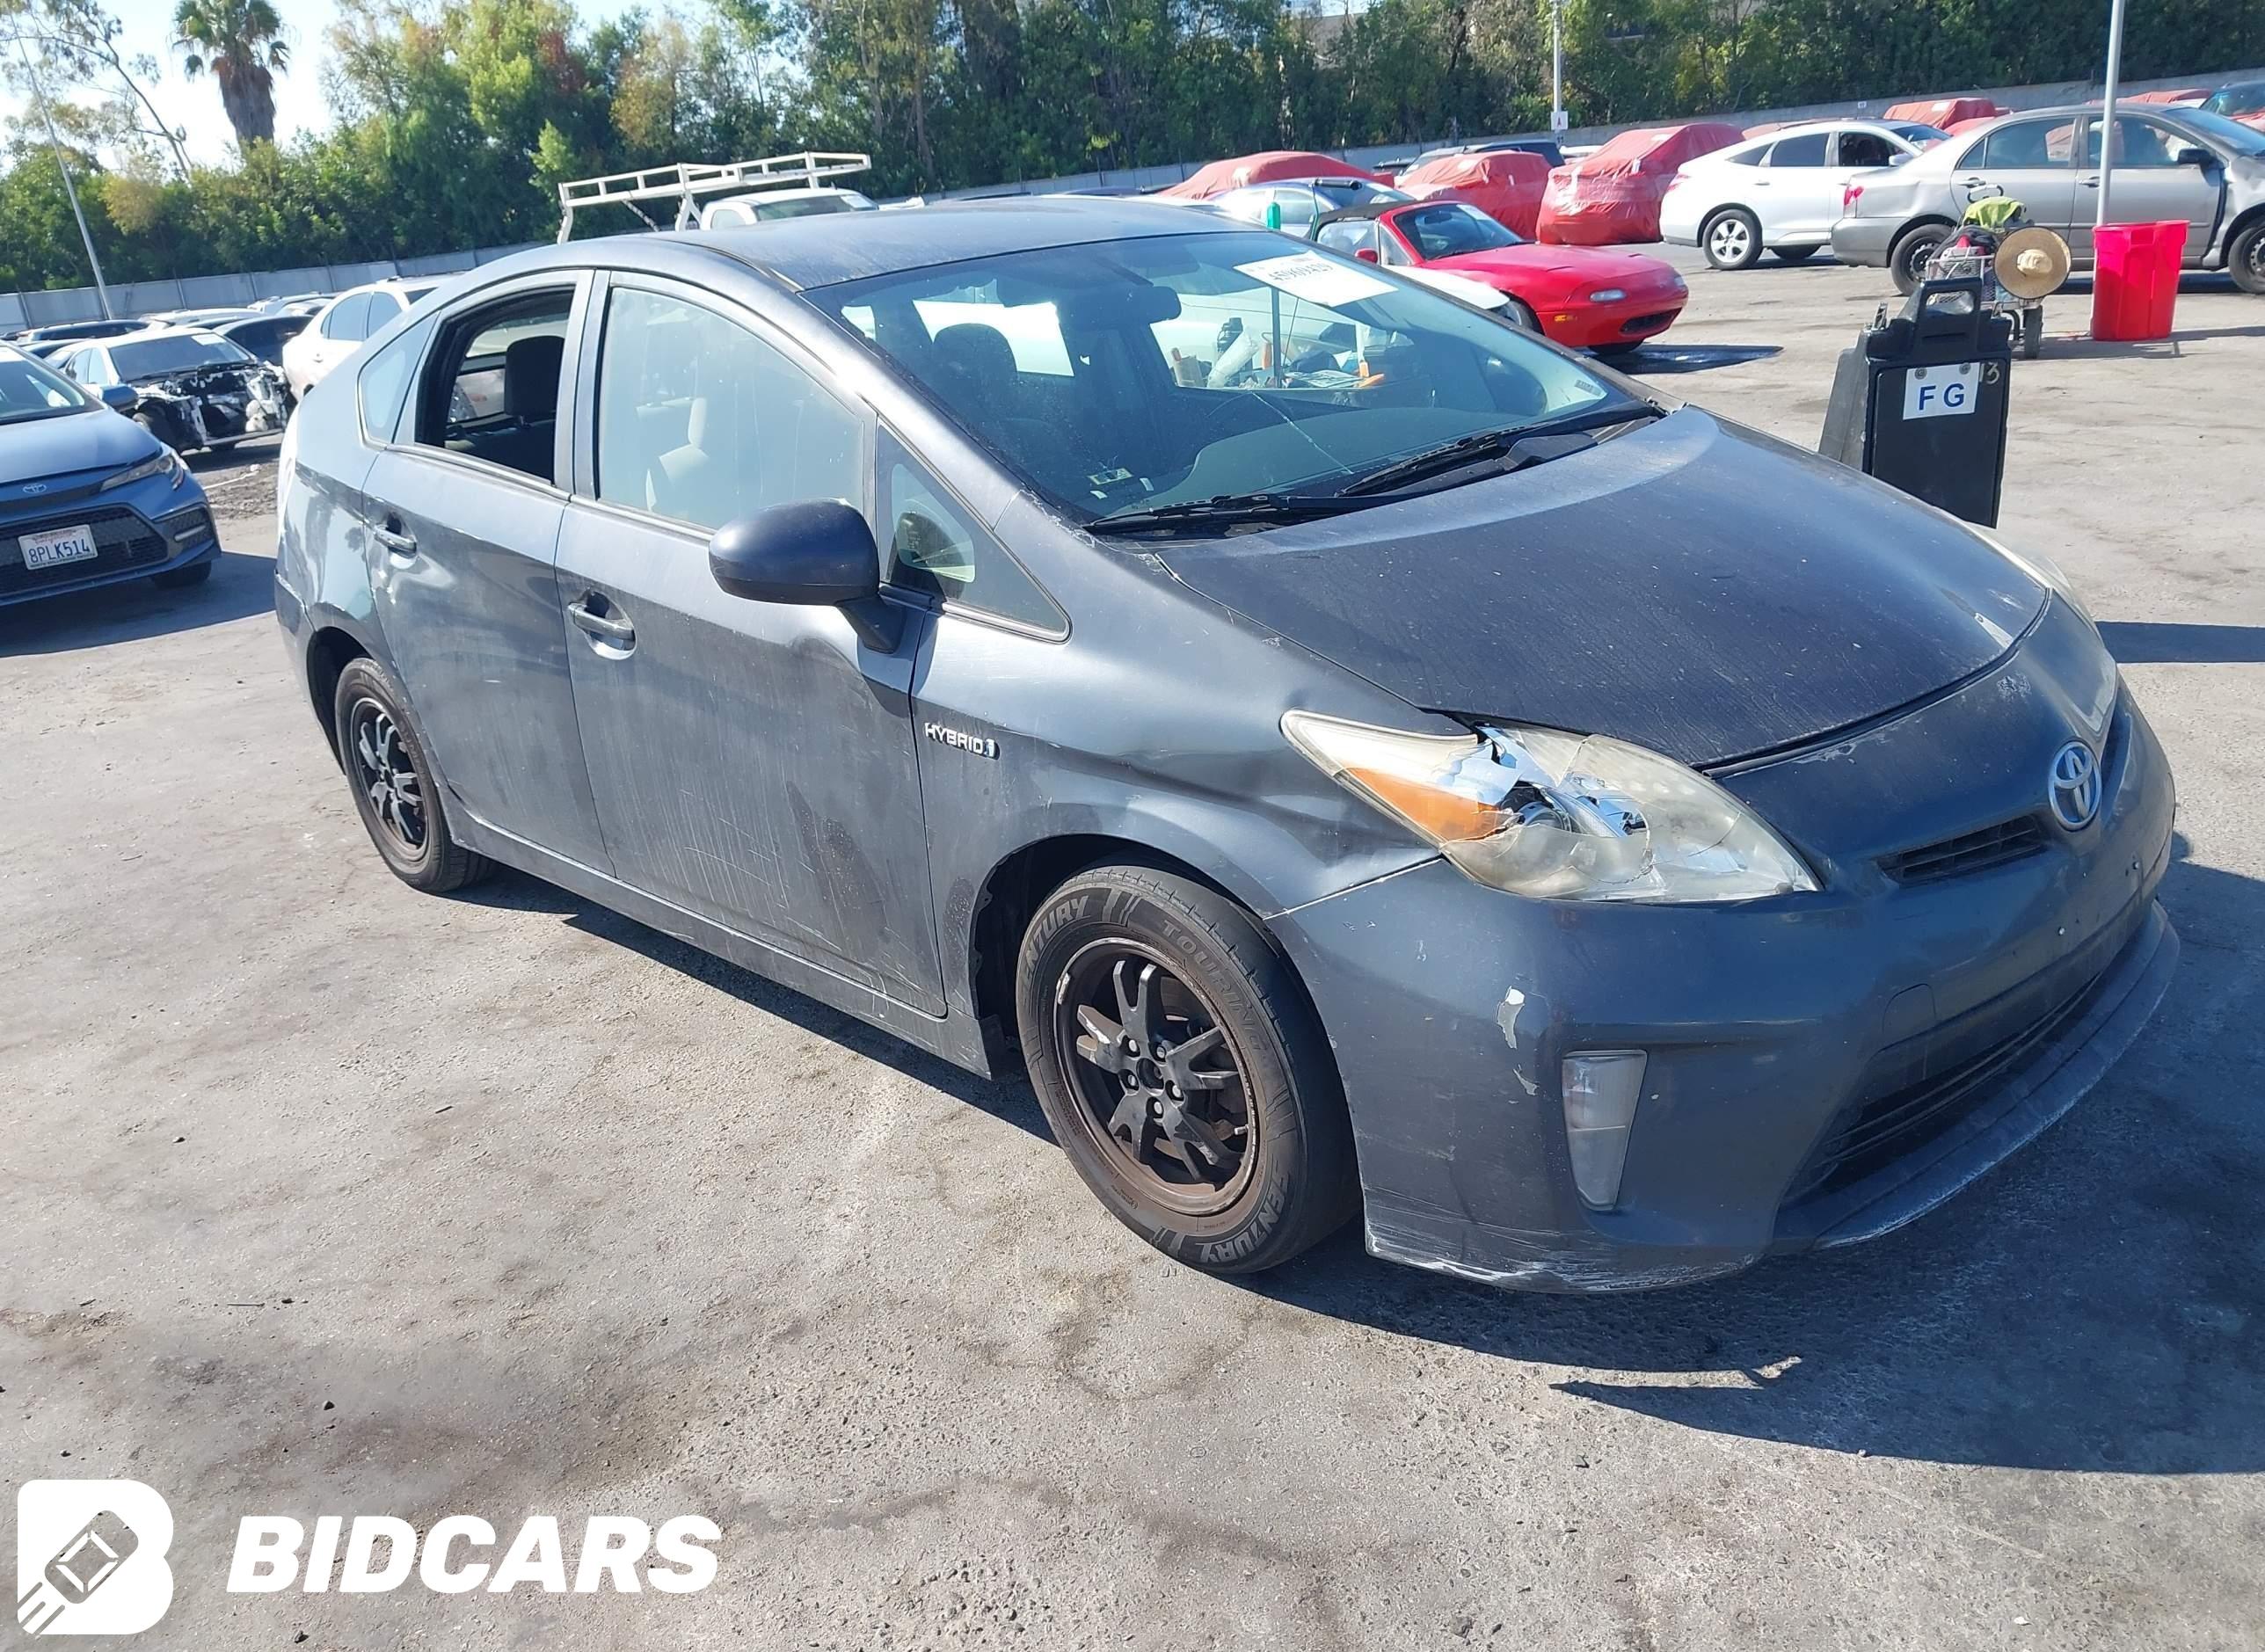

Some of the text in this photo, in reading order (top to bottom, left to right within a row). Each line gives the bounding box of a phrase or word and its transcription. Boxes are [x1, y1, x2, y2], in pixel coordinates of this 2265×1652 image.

[28, 538, 90, 564] 8PLK514
[924, 722, 983, 754] HYBRID
[1160, 920, 1267, 1051] TOURING
